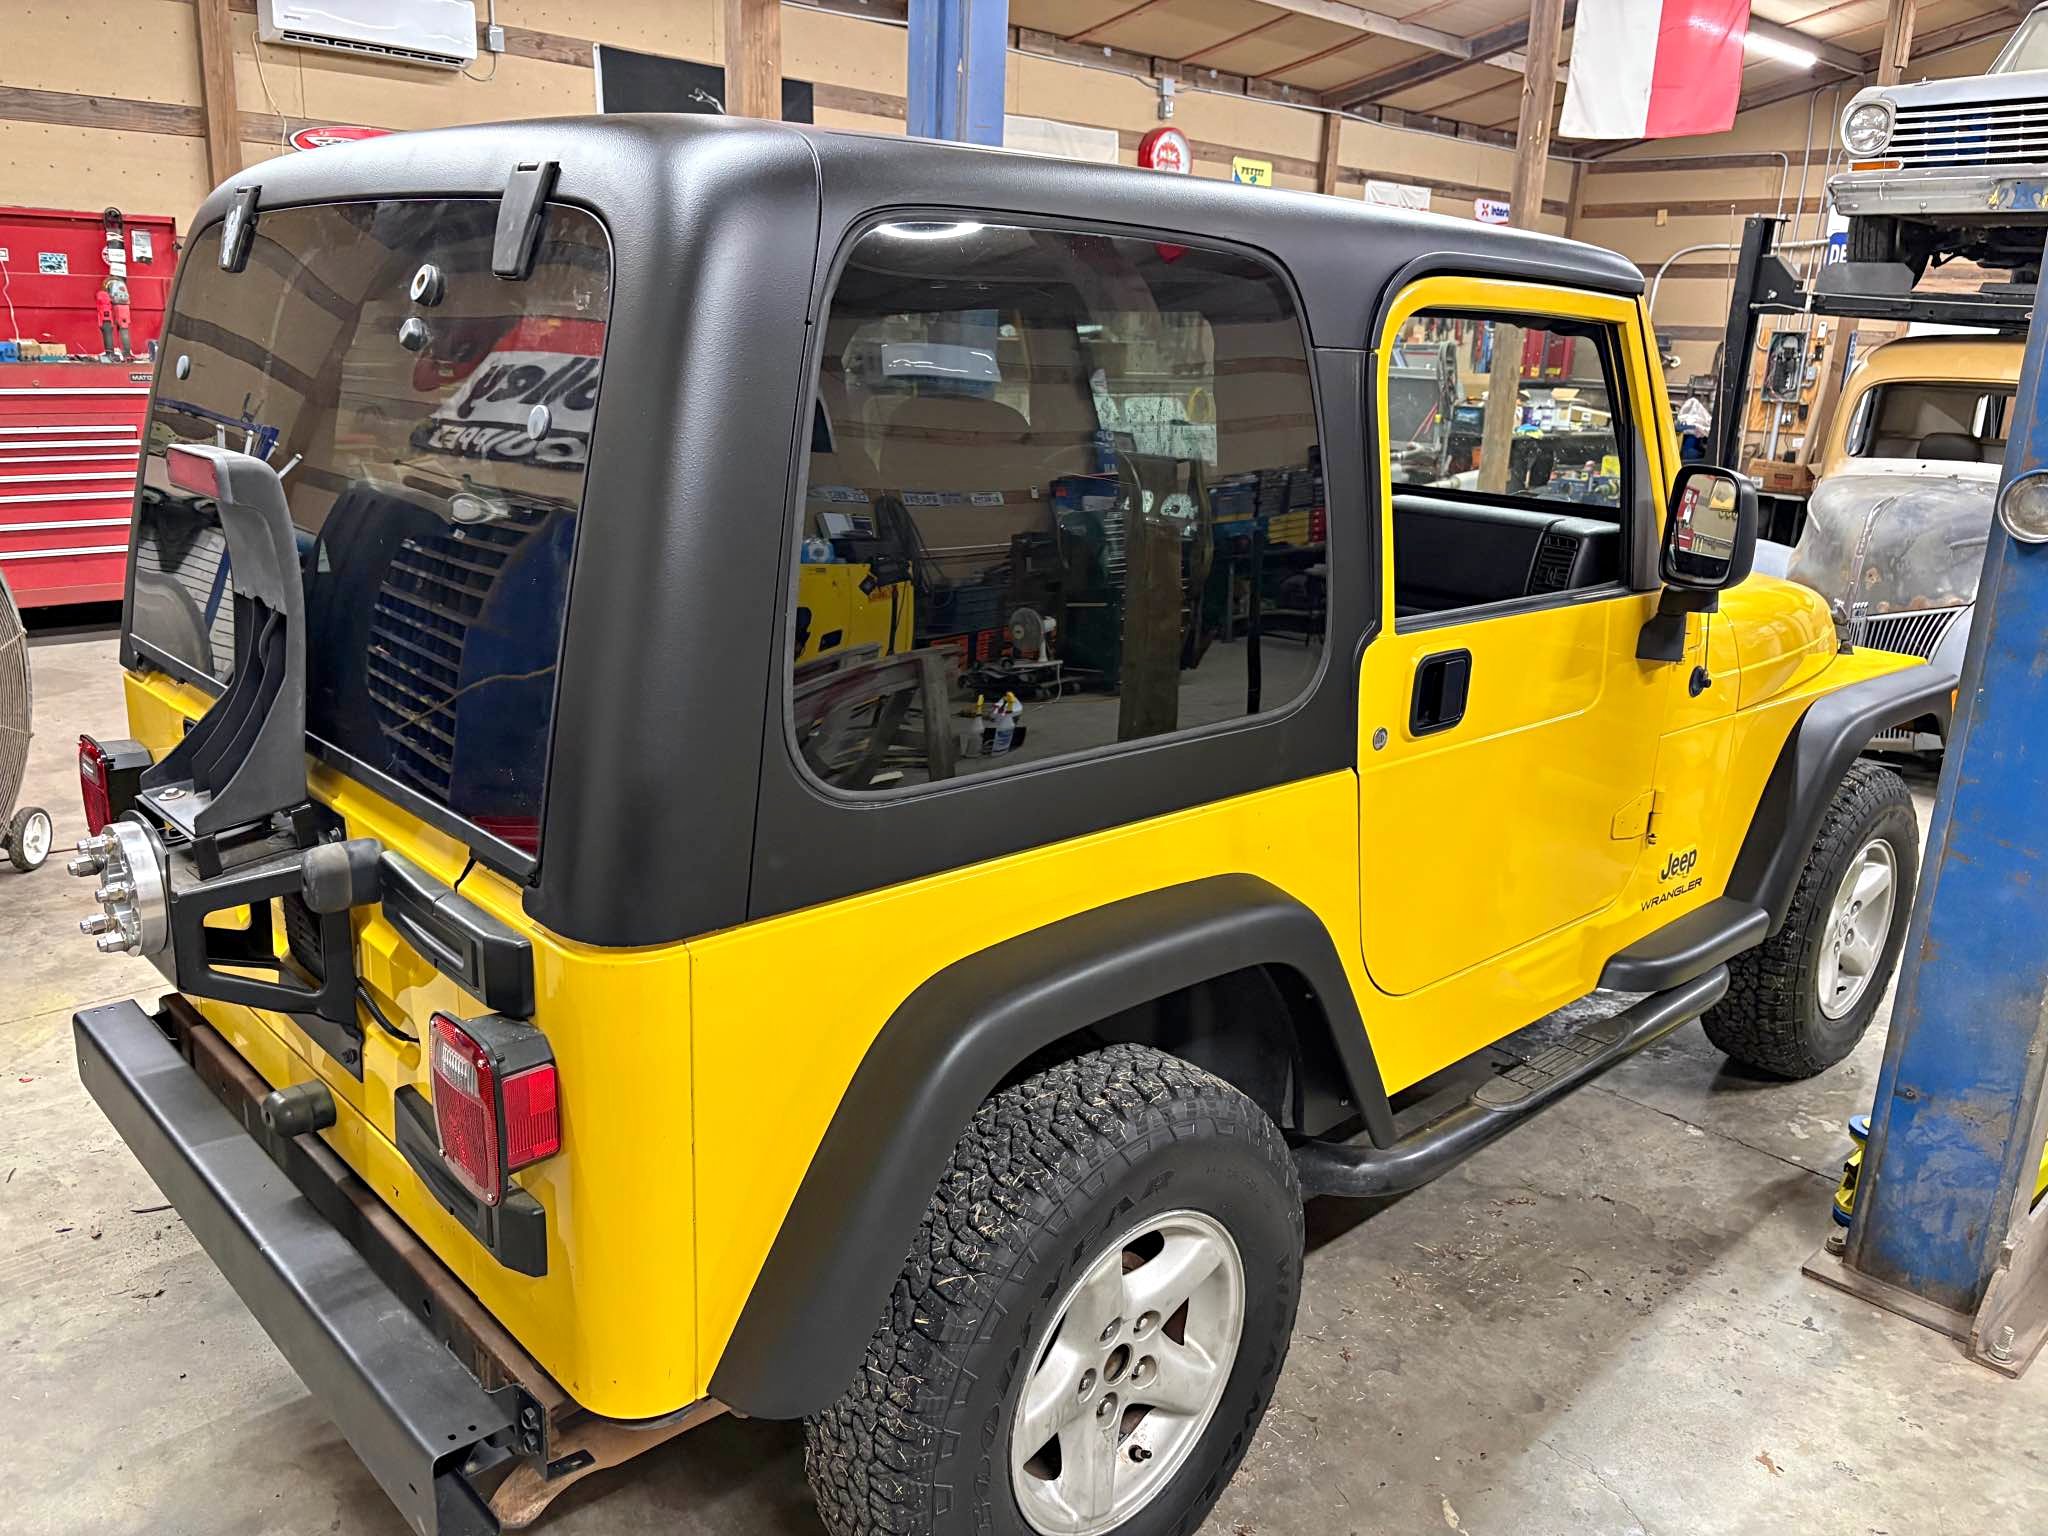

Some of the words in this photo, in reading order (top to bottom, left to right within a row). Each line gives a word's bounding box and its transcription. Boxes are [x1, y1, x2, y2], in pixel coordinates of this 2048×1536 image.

[1828, 244, 1848, 265] DE
[1661, 849, 1697, 880] Jeep
[1641, 877, 1703, 911] WRANGLER
